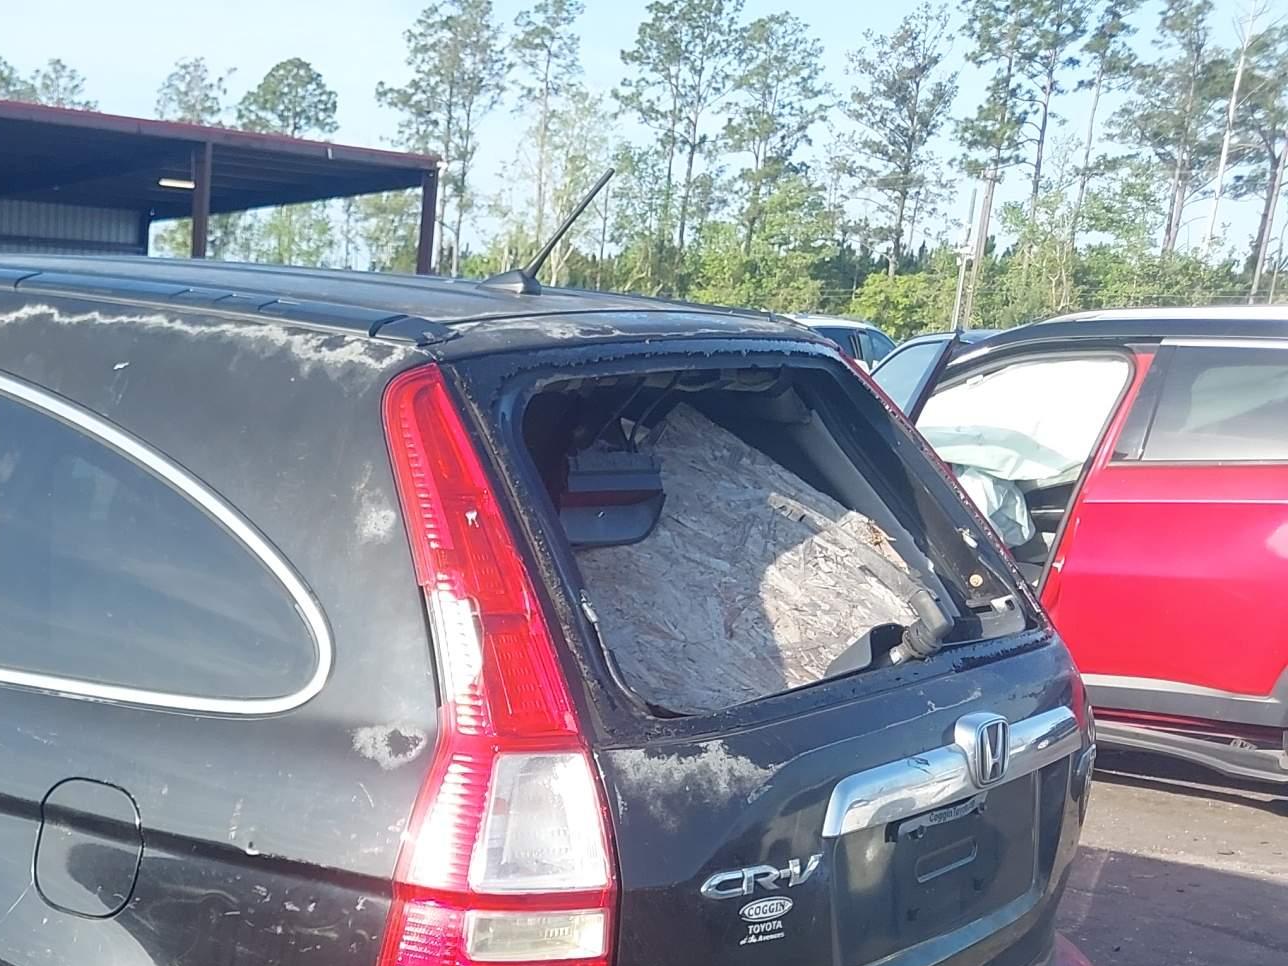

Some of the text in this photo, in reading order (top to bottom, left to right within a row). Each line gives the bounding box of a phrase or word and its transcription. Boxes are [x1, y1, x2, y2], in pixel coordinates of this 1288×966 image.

[700, 853, 823, 898] CR-V
[747, 901, 785, 917] COGGIN
[748, 920, 783, 935] TOYOTA
